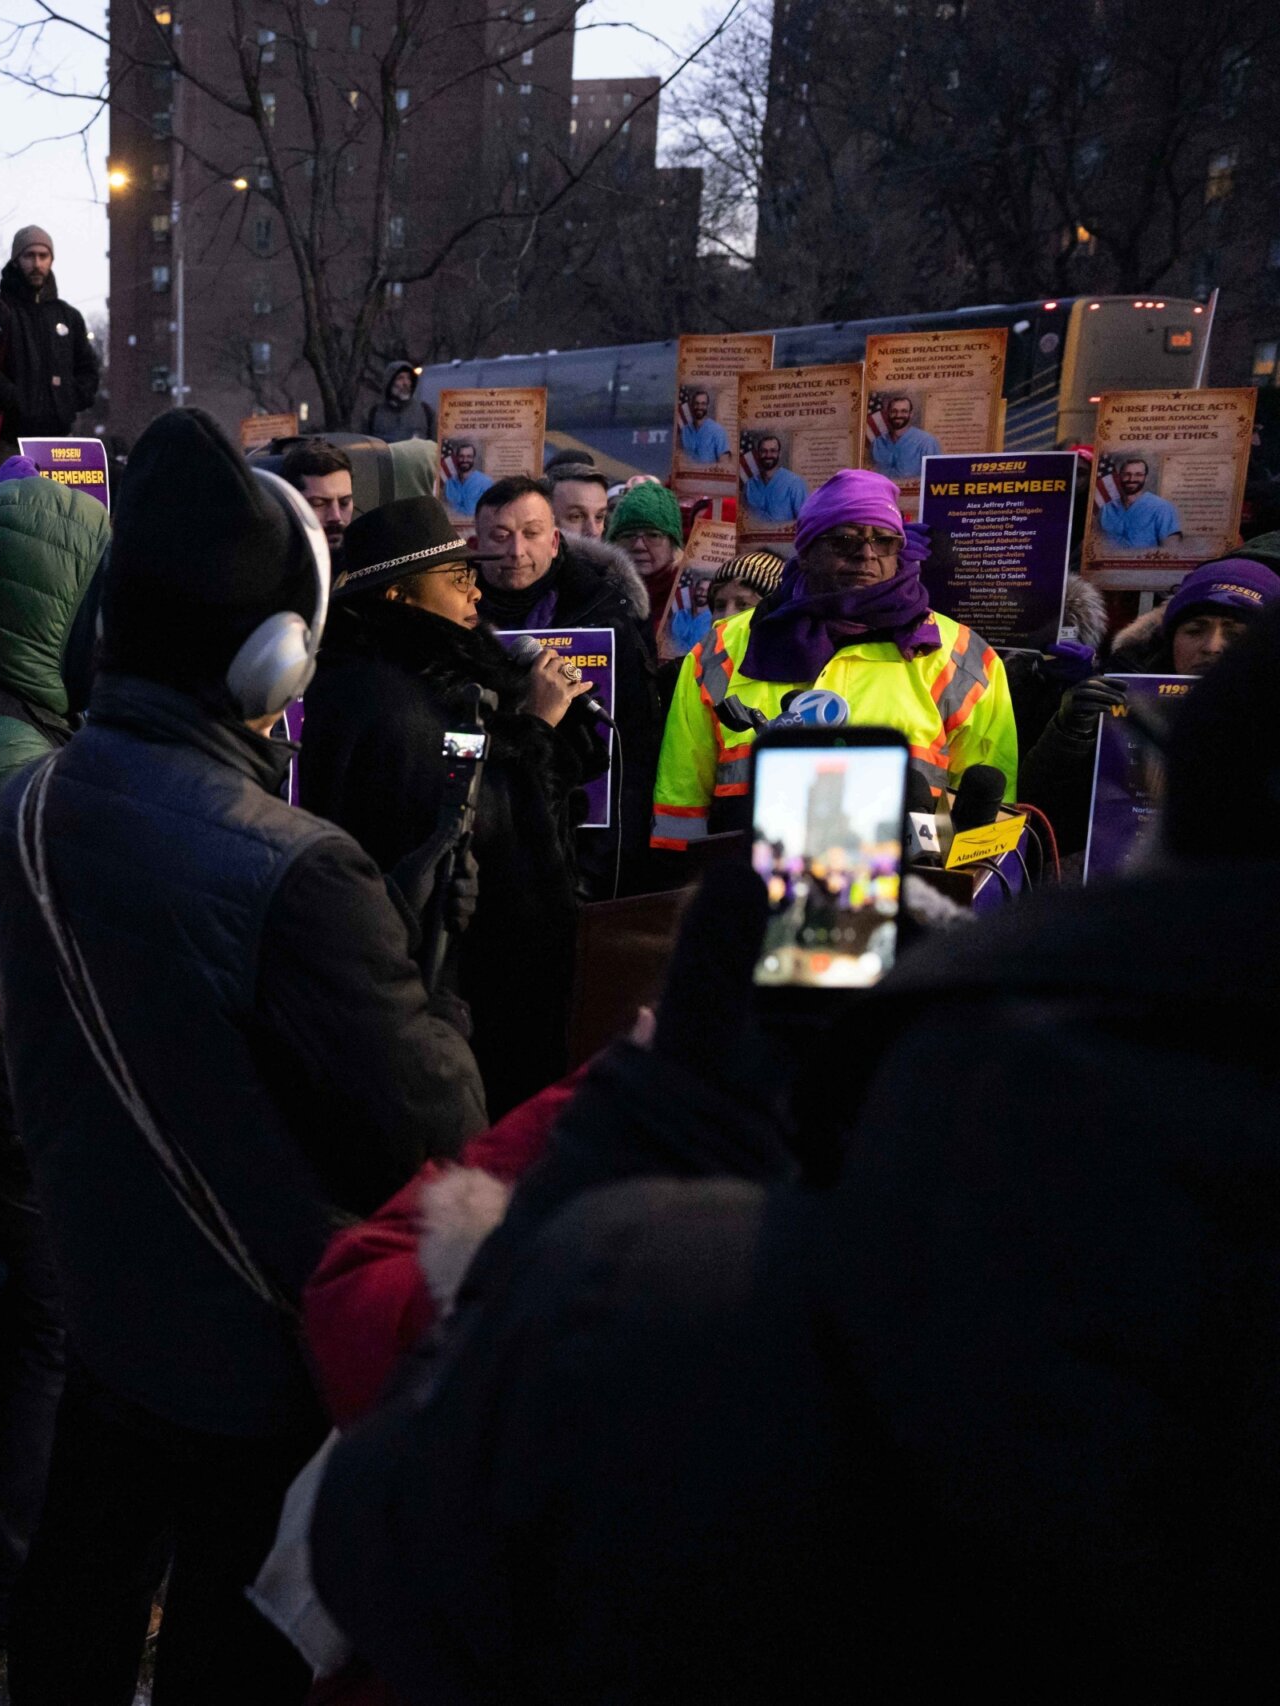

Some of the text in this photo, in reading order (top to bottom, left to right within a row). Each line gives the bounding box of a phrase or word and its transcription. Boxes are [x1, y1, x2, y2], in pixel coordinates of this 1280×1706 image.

[877, 343, 991, 355] NURSE PRACTICE ACTS
[885, 370, 975, 380] CODE OF ETHICS
[746, 378, 851, 392] NURSE PRACTICE ACTS
[448, 400, 473, 408] NURSE
[1111, 402, 1238, 413] NURSE PRACTICE ACTS
[754, 407, 837, 419] CODE OF ETHICS
[1119, 431, 1219, 441] CODE OF ETHICS
[970, 461, 1027, 473] 1199SEIU
[52, 470, 104, 485] REMEMBER
[930, 480, 1066, 496] WE REMEMBER
[701, 531, 729, 540] NURSE
[563, 655, 608, 667] MBER
[918, 823, 933, 840] 4
[954, 842, 1008, 862] Aladino TV
